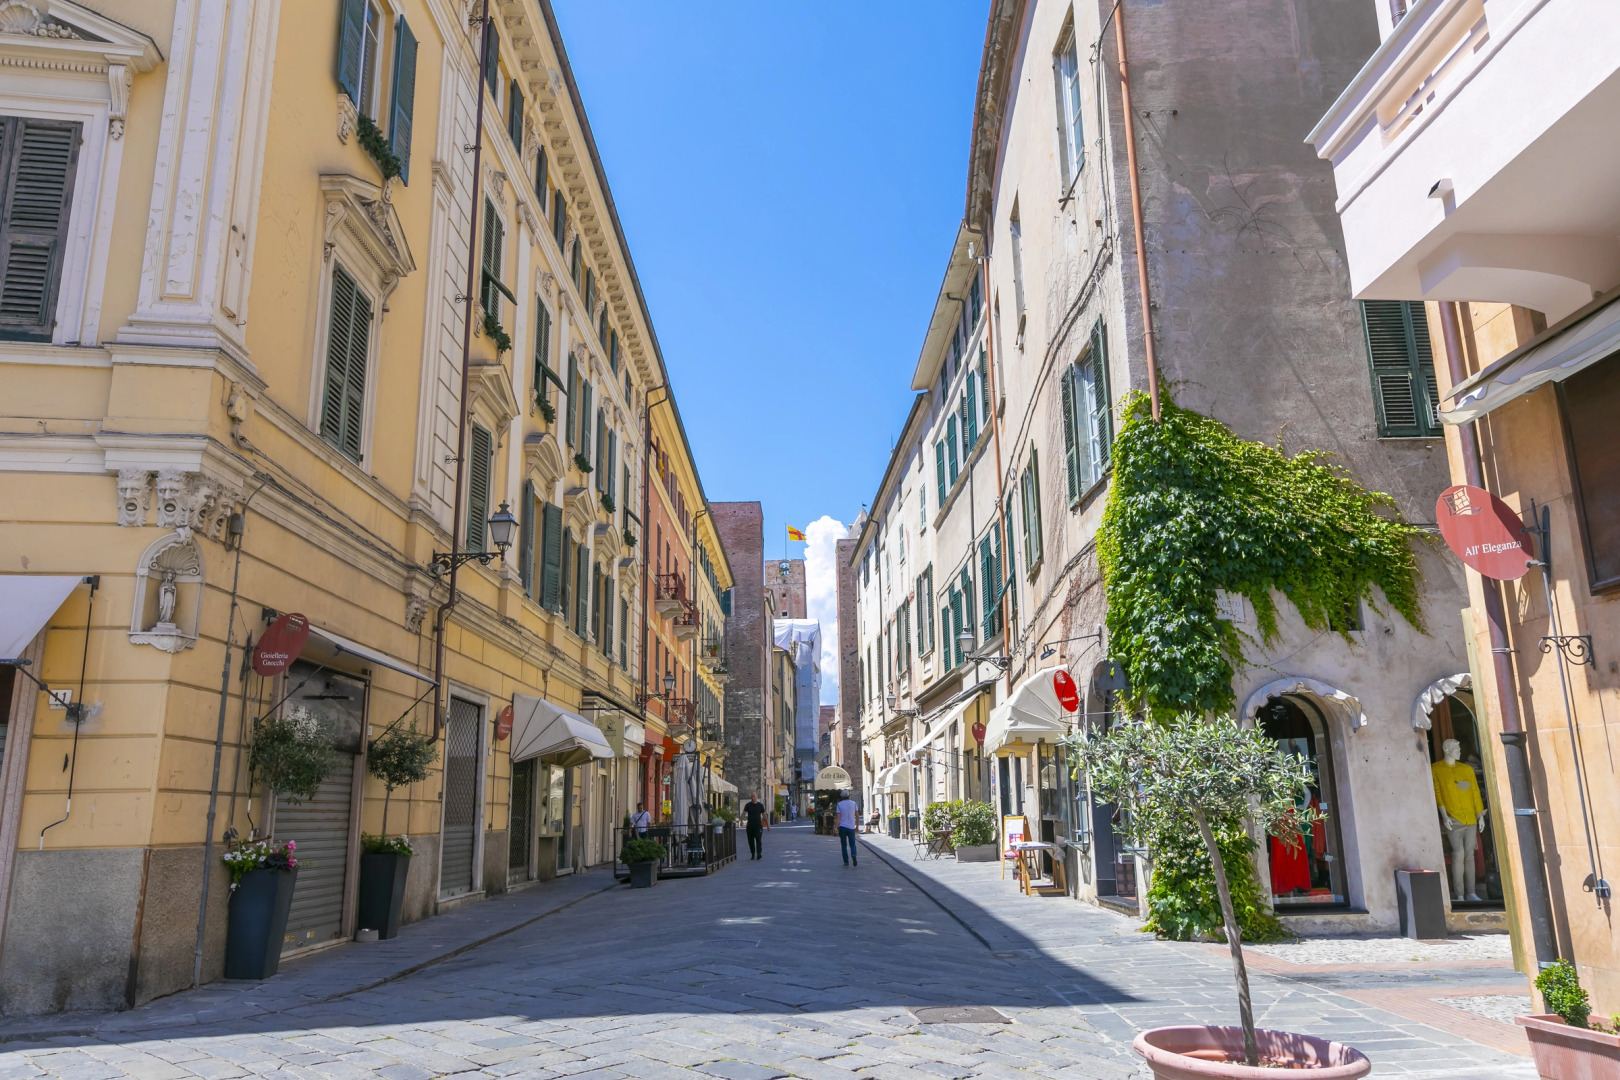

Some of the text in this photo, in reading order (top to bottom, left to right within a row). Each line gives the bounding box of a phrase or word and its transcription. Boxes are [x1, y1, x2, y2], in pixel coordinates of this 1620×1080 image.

[1465, 540, 1522, 557] All' Eleganza
[262, 659, 285, 667] Gnocchi
